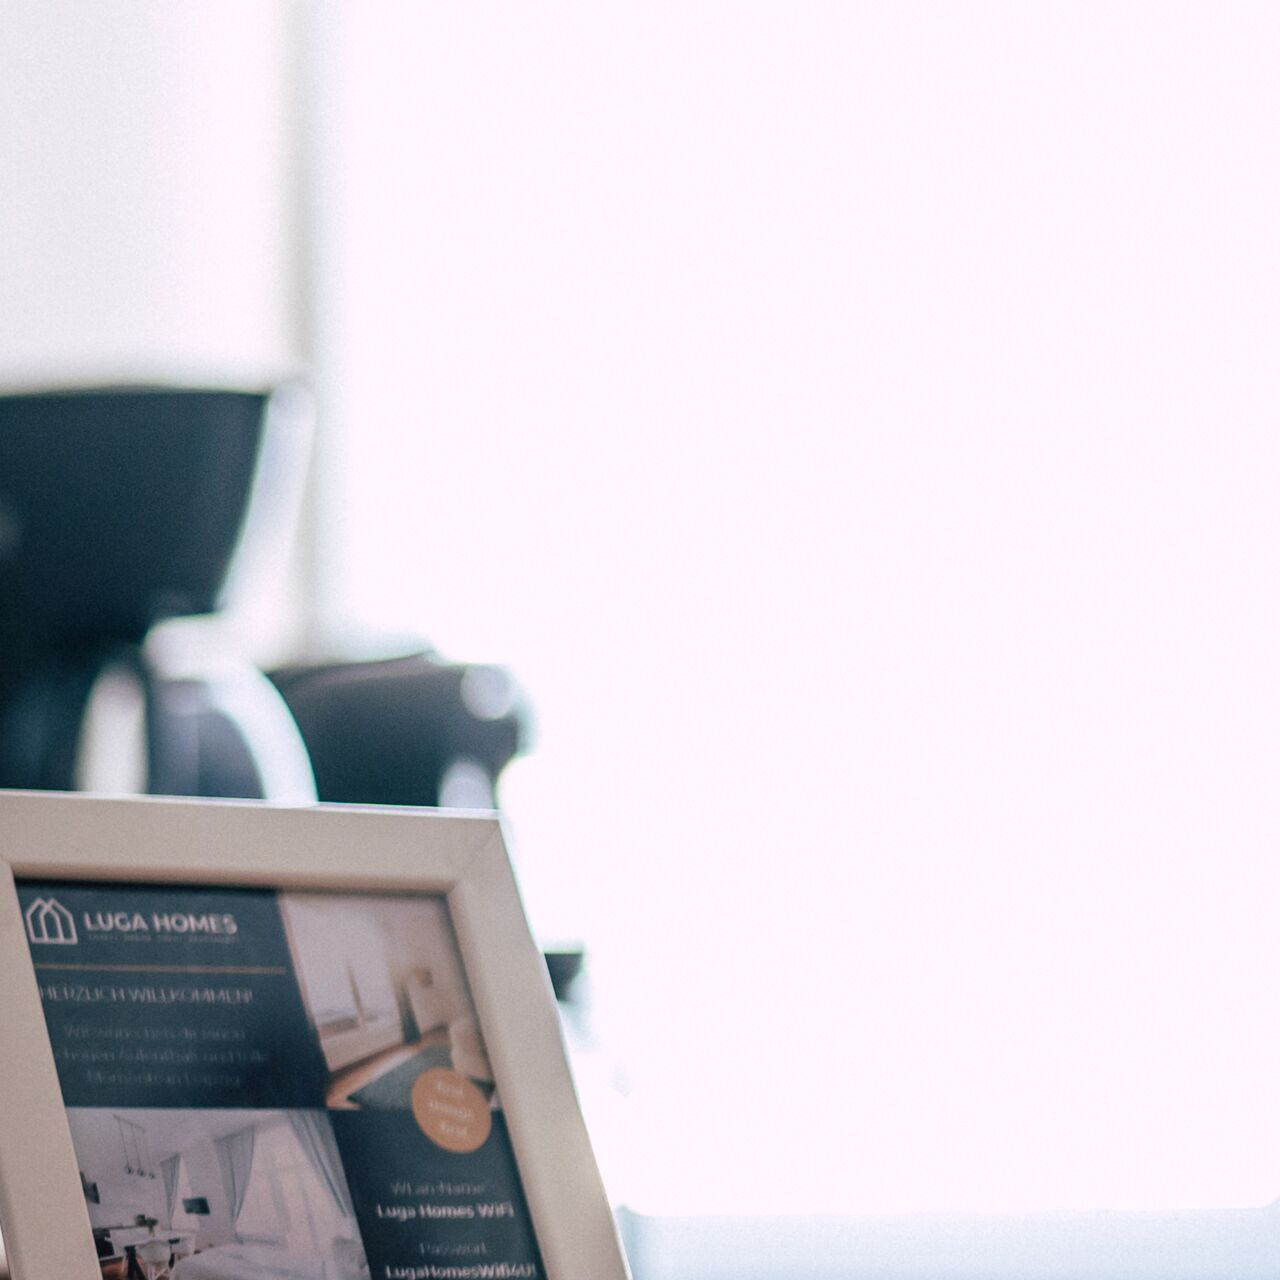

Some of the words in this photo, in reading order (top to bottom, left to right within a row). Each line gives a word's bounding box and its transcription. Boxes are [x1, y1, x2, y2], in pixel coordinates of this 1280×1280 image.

[83, 912, 149, 932] LUGA
[153, 913, 238, 935] HOMES
[376, 1203, 417, 1222] Luga
[420, 1204, 475, 1219] Homes
